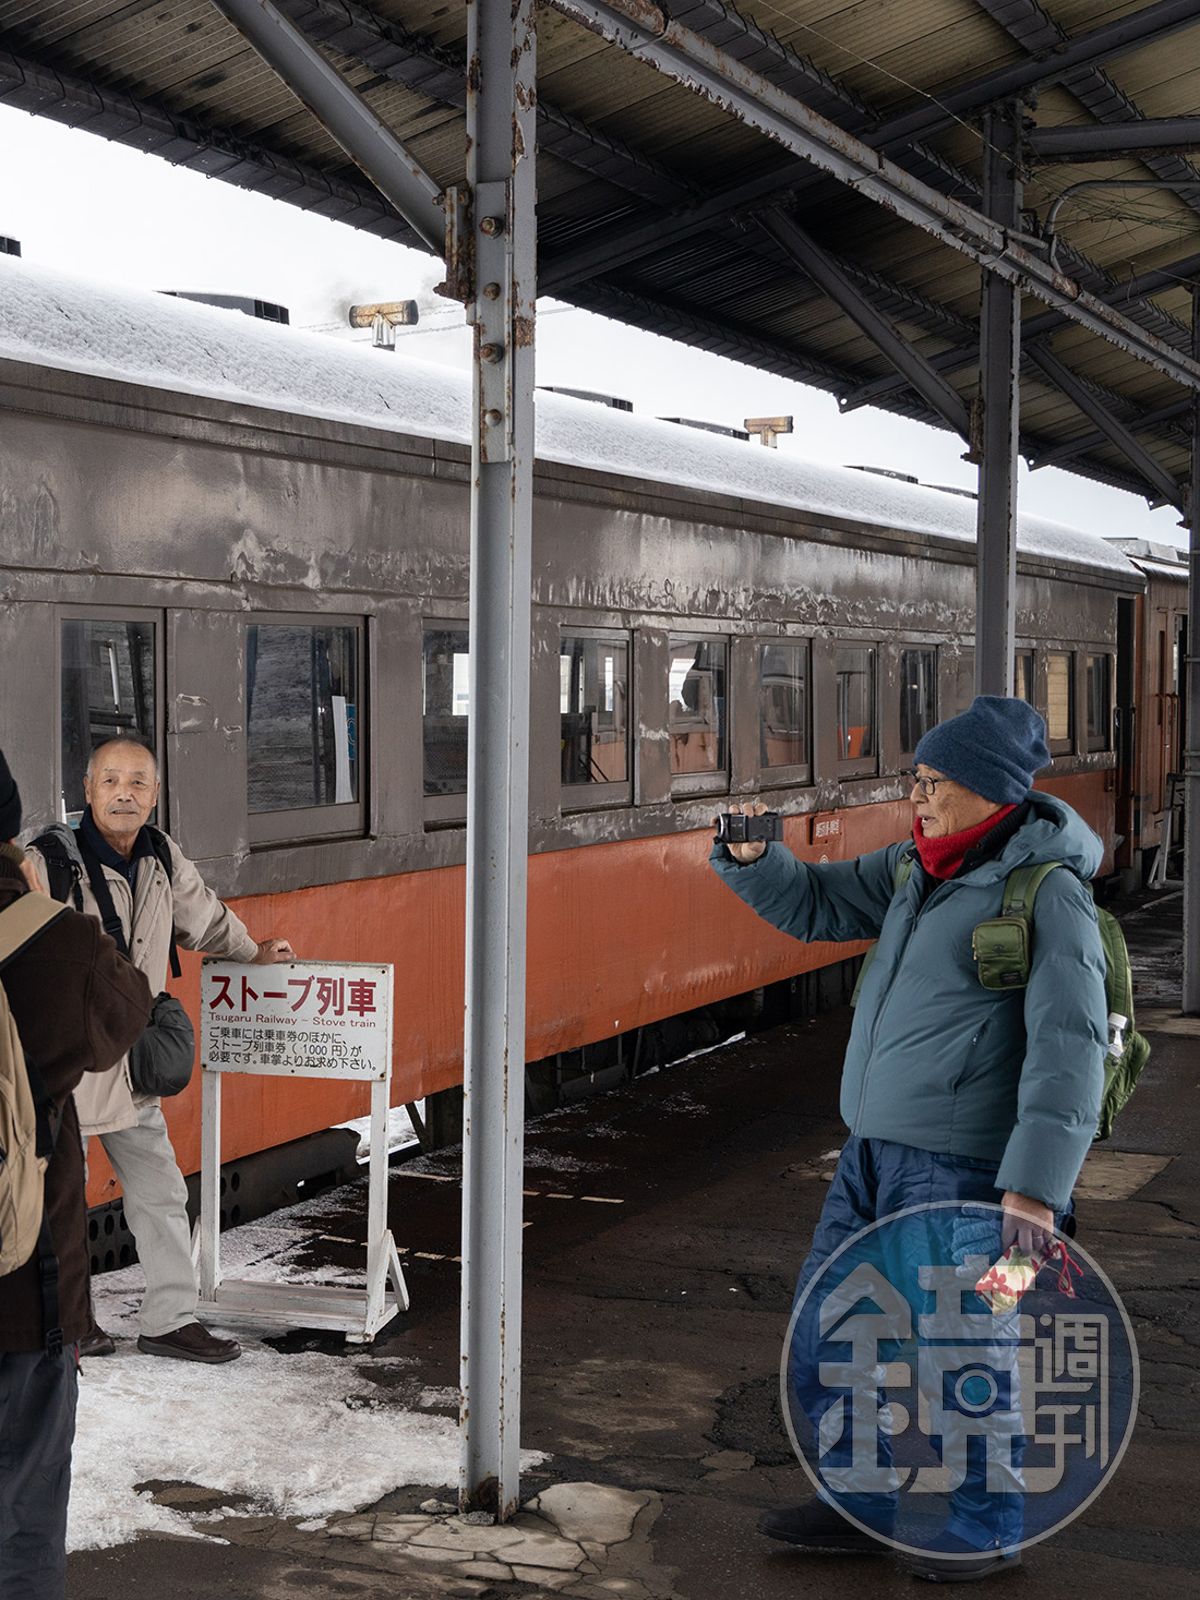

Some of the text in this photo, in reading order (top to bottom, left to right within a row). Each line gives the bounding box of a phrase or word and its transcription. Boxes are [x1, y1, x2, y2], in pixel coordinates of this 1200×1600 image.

[209, 975, 376, 1017] ストーブ列車
[208, 1012, 252, 1023] Tsugaru
[256, 1014, 297, 1026] Railway
[313, 1017, 345, 1027] Stove
[350, 1019, 376, 1028] train
